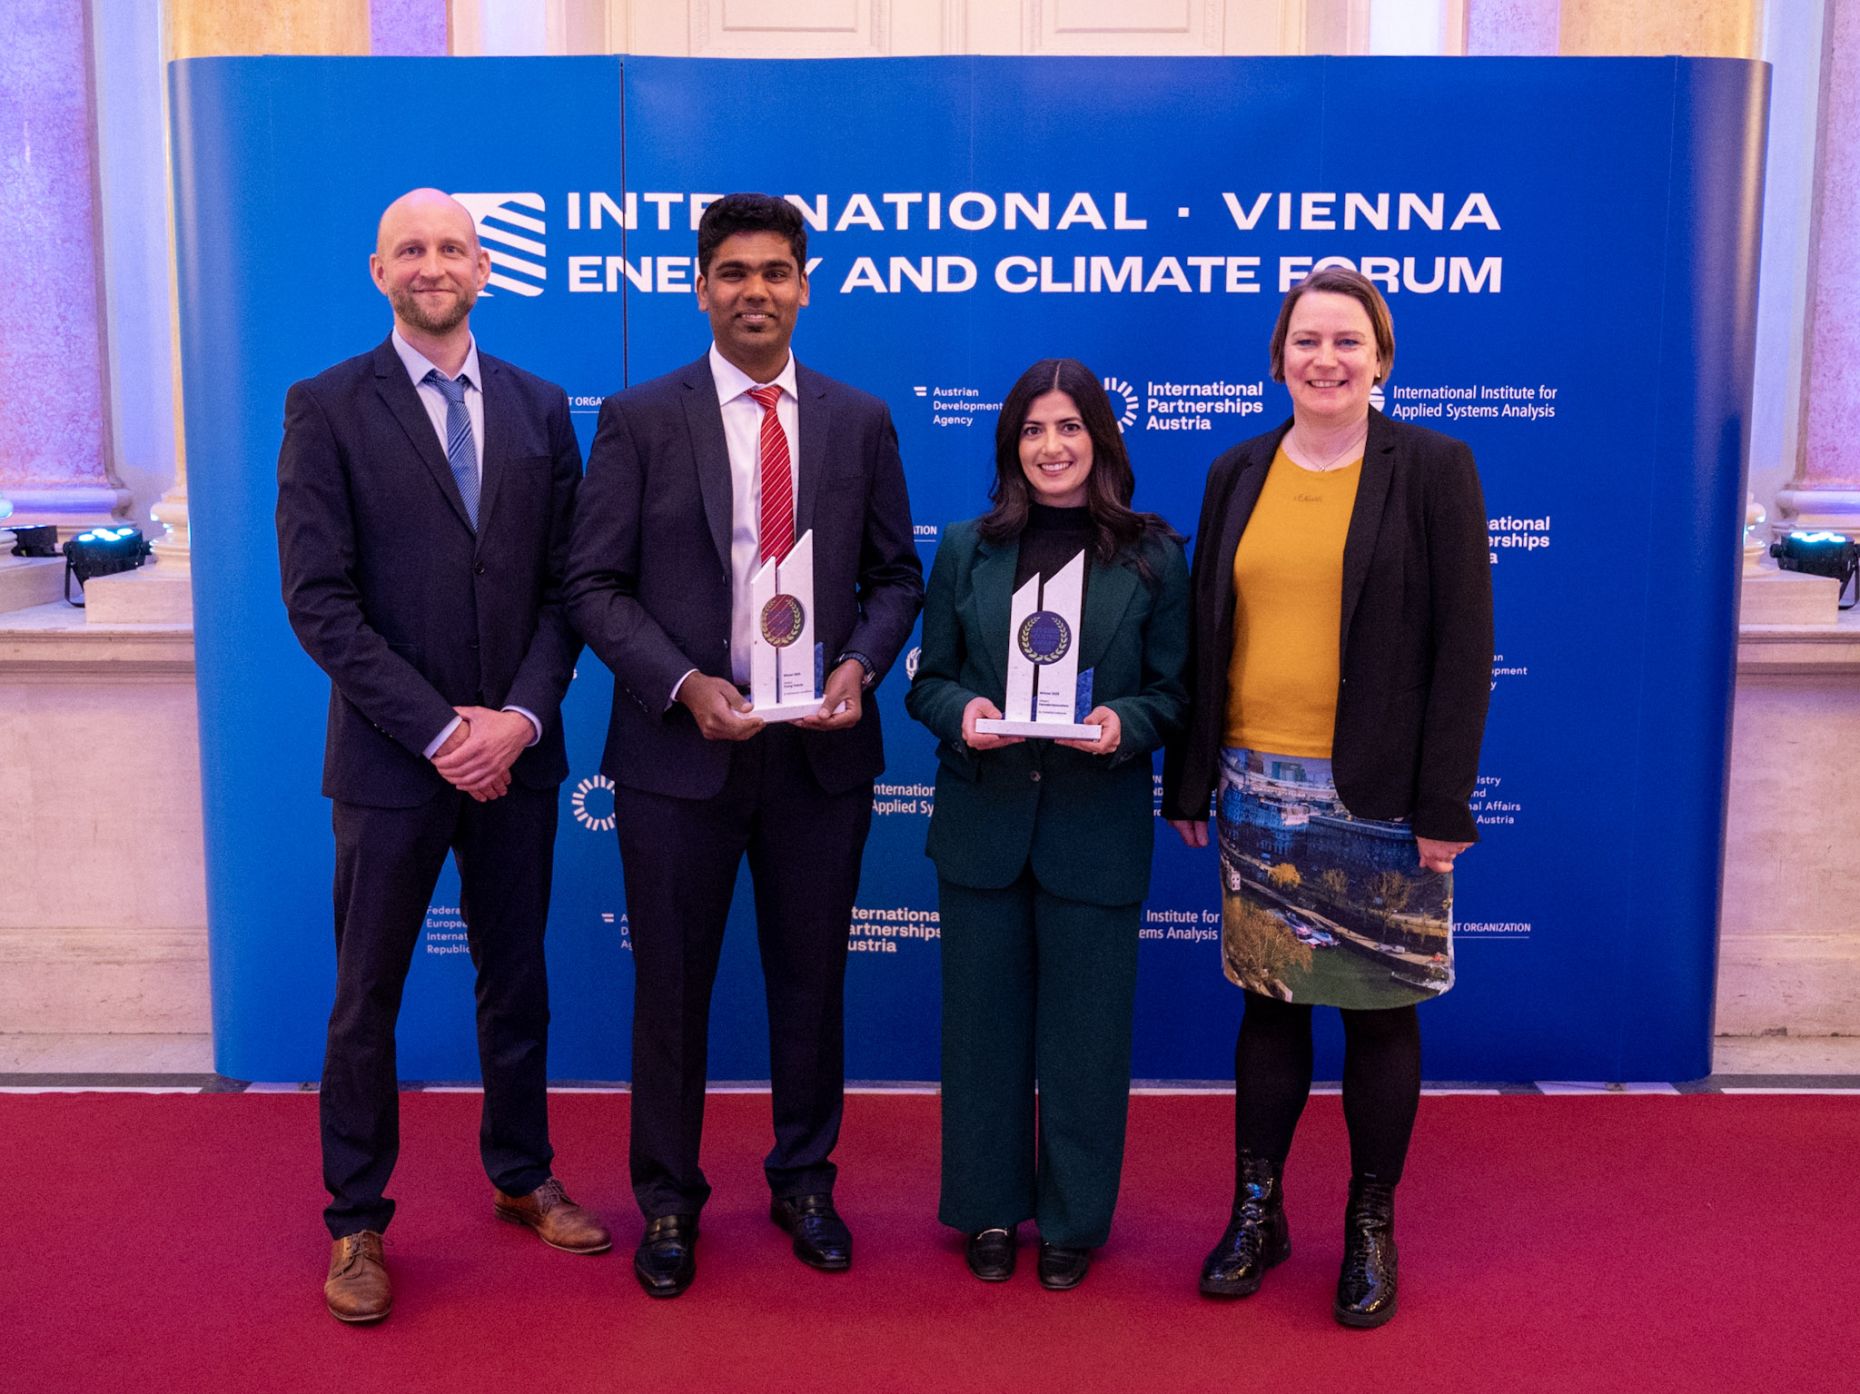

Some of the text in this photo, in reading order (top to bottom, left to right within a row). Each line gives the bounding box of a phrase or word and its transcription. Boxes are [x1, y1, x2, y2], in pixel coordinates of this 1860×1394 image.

[568, 191, 1147, 231] INTENATIONAL
[1222, 192, 1502, 231] VIENNA
[840, 256, 977, 293] AND
[994, 255, 1260, 293] CLIMATE
[933, 386, 979, 397] Austrian
[1147, 381, 1264, 396] International
[1393, 384, 1558, 400] International Institute for
[933, 400, 1003, 413] Development
[1147, 398, 1264, 417] Partnerships
[1392, 403, 1556, 421] Applied Systems Analysis
[933, 414, 973, 427] Agency
[1146, 415, 1212, 430] Austria
[1485, 800, 1521, 811] Affairs
[1476, 814, 1515, 824] Austria
[1146, 909, 1220, 923] Institute for
[1166, 926, 1218, 944] Analysis
[1463, 922, 1531, 933] ORGANIZATION
